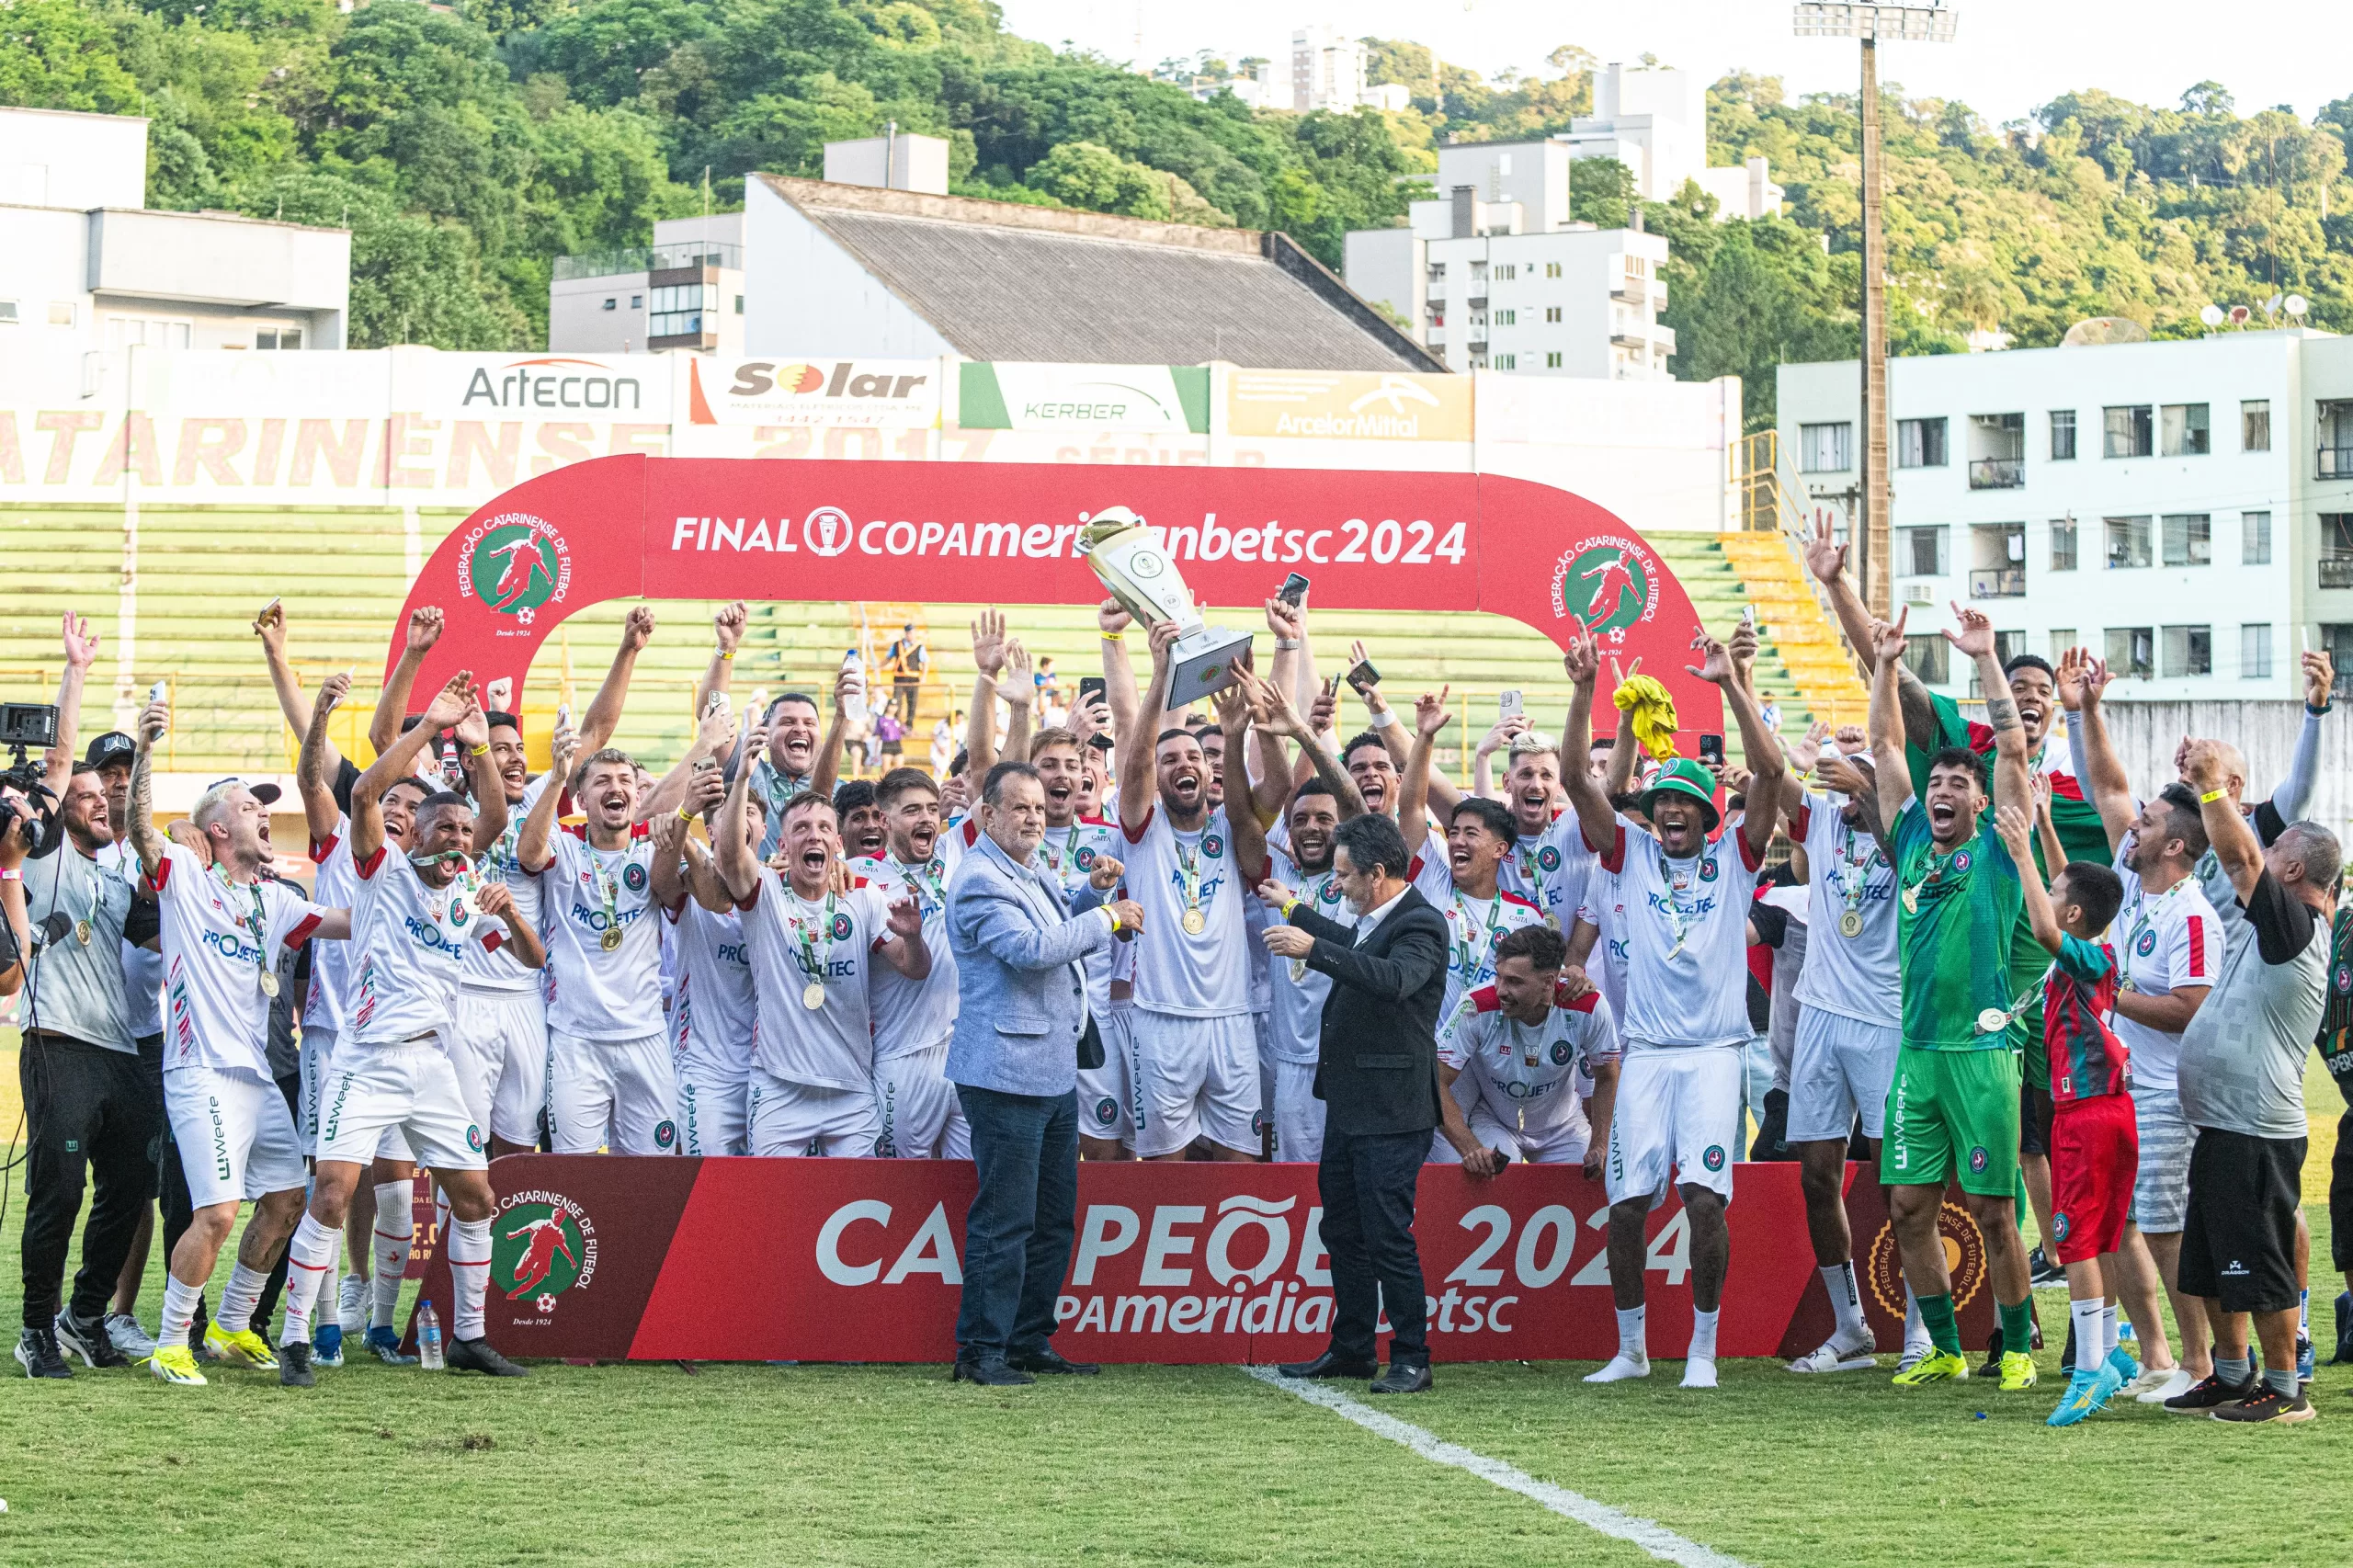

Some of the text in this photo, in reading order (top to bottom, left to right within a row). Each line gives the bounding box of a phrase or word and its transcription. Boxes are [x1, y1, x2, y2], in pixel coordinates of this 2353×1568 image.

[461, 368, 640, 409] Artecon
[1025, 403, 1127, 420] KERBER
[1276, 412, 1418, 437] ArcelorMittal
[458, 513, 572, 604] FEDERAÇÃO CATARINENSE DE FUTEBOL
[672, 517, 798, 551] FINAL
[1335, 518, 1467, 564] 2024
[1552, 536, 1659, 623] FEDERAÇÃO CATARINENSE DE FUTEBOL
[210, 1096, 227, 1158] Weefe
[1893, 1074, 1907, 1144] Weefe
[501, 1190, 597, 1289] CATARINENSE DE FUTEBOL
[1444, 1204, 1692, 1288] 2024
[1879, 1228, 1977, 1290] FEDERAÇÃ DE FUTEBOL
